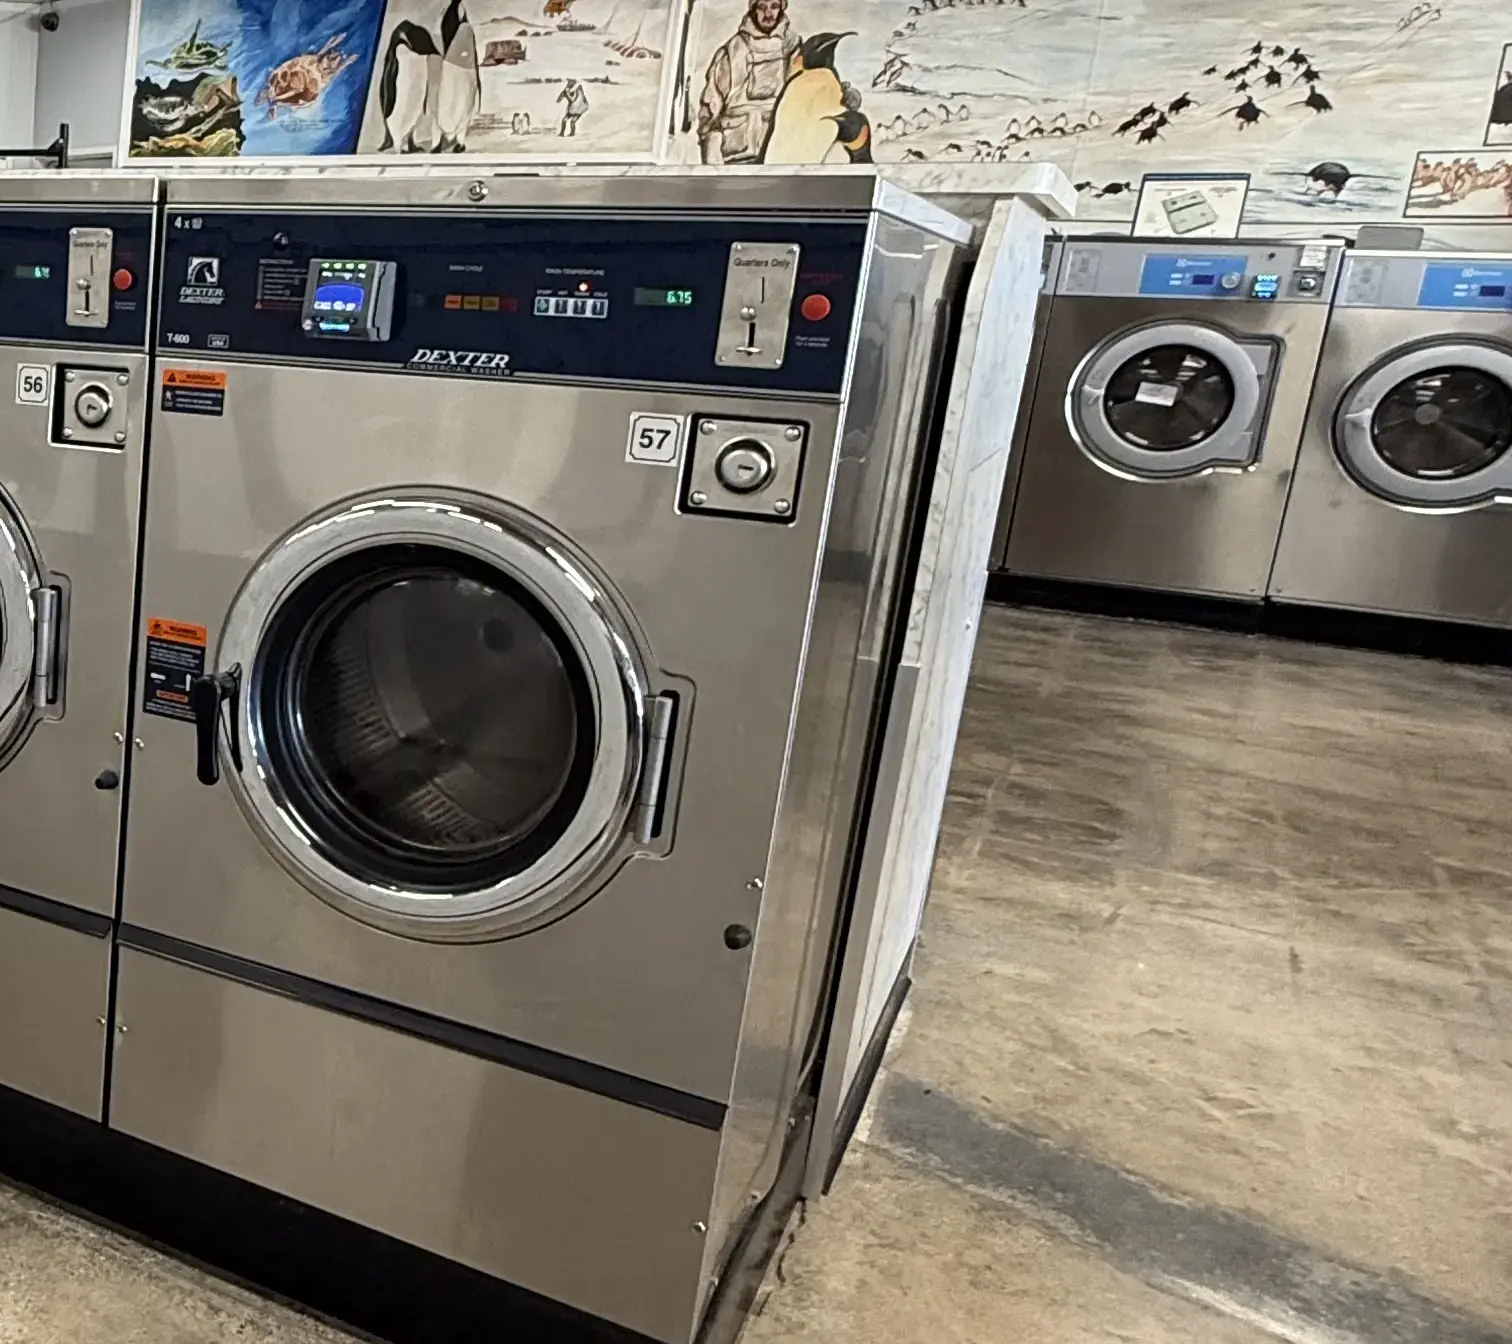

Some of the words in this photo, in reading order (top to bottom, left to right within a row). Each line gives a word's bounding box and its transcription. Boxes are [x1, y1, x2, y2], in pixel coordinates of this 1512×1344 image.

[174, 216, 182, 229] 4
[733, 257, 769, 268] Quarters
[770, 257, 791, 270] Only
[179, 287, 225, 297] DEXTER
[410, 348, 510, 368] DEXTER
[470, 366, 511, 376] WASHER
[23, 375, 43, 394] 56
[638, 428, 672, 450] 57
